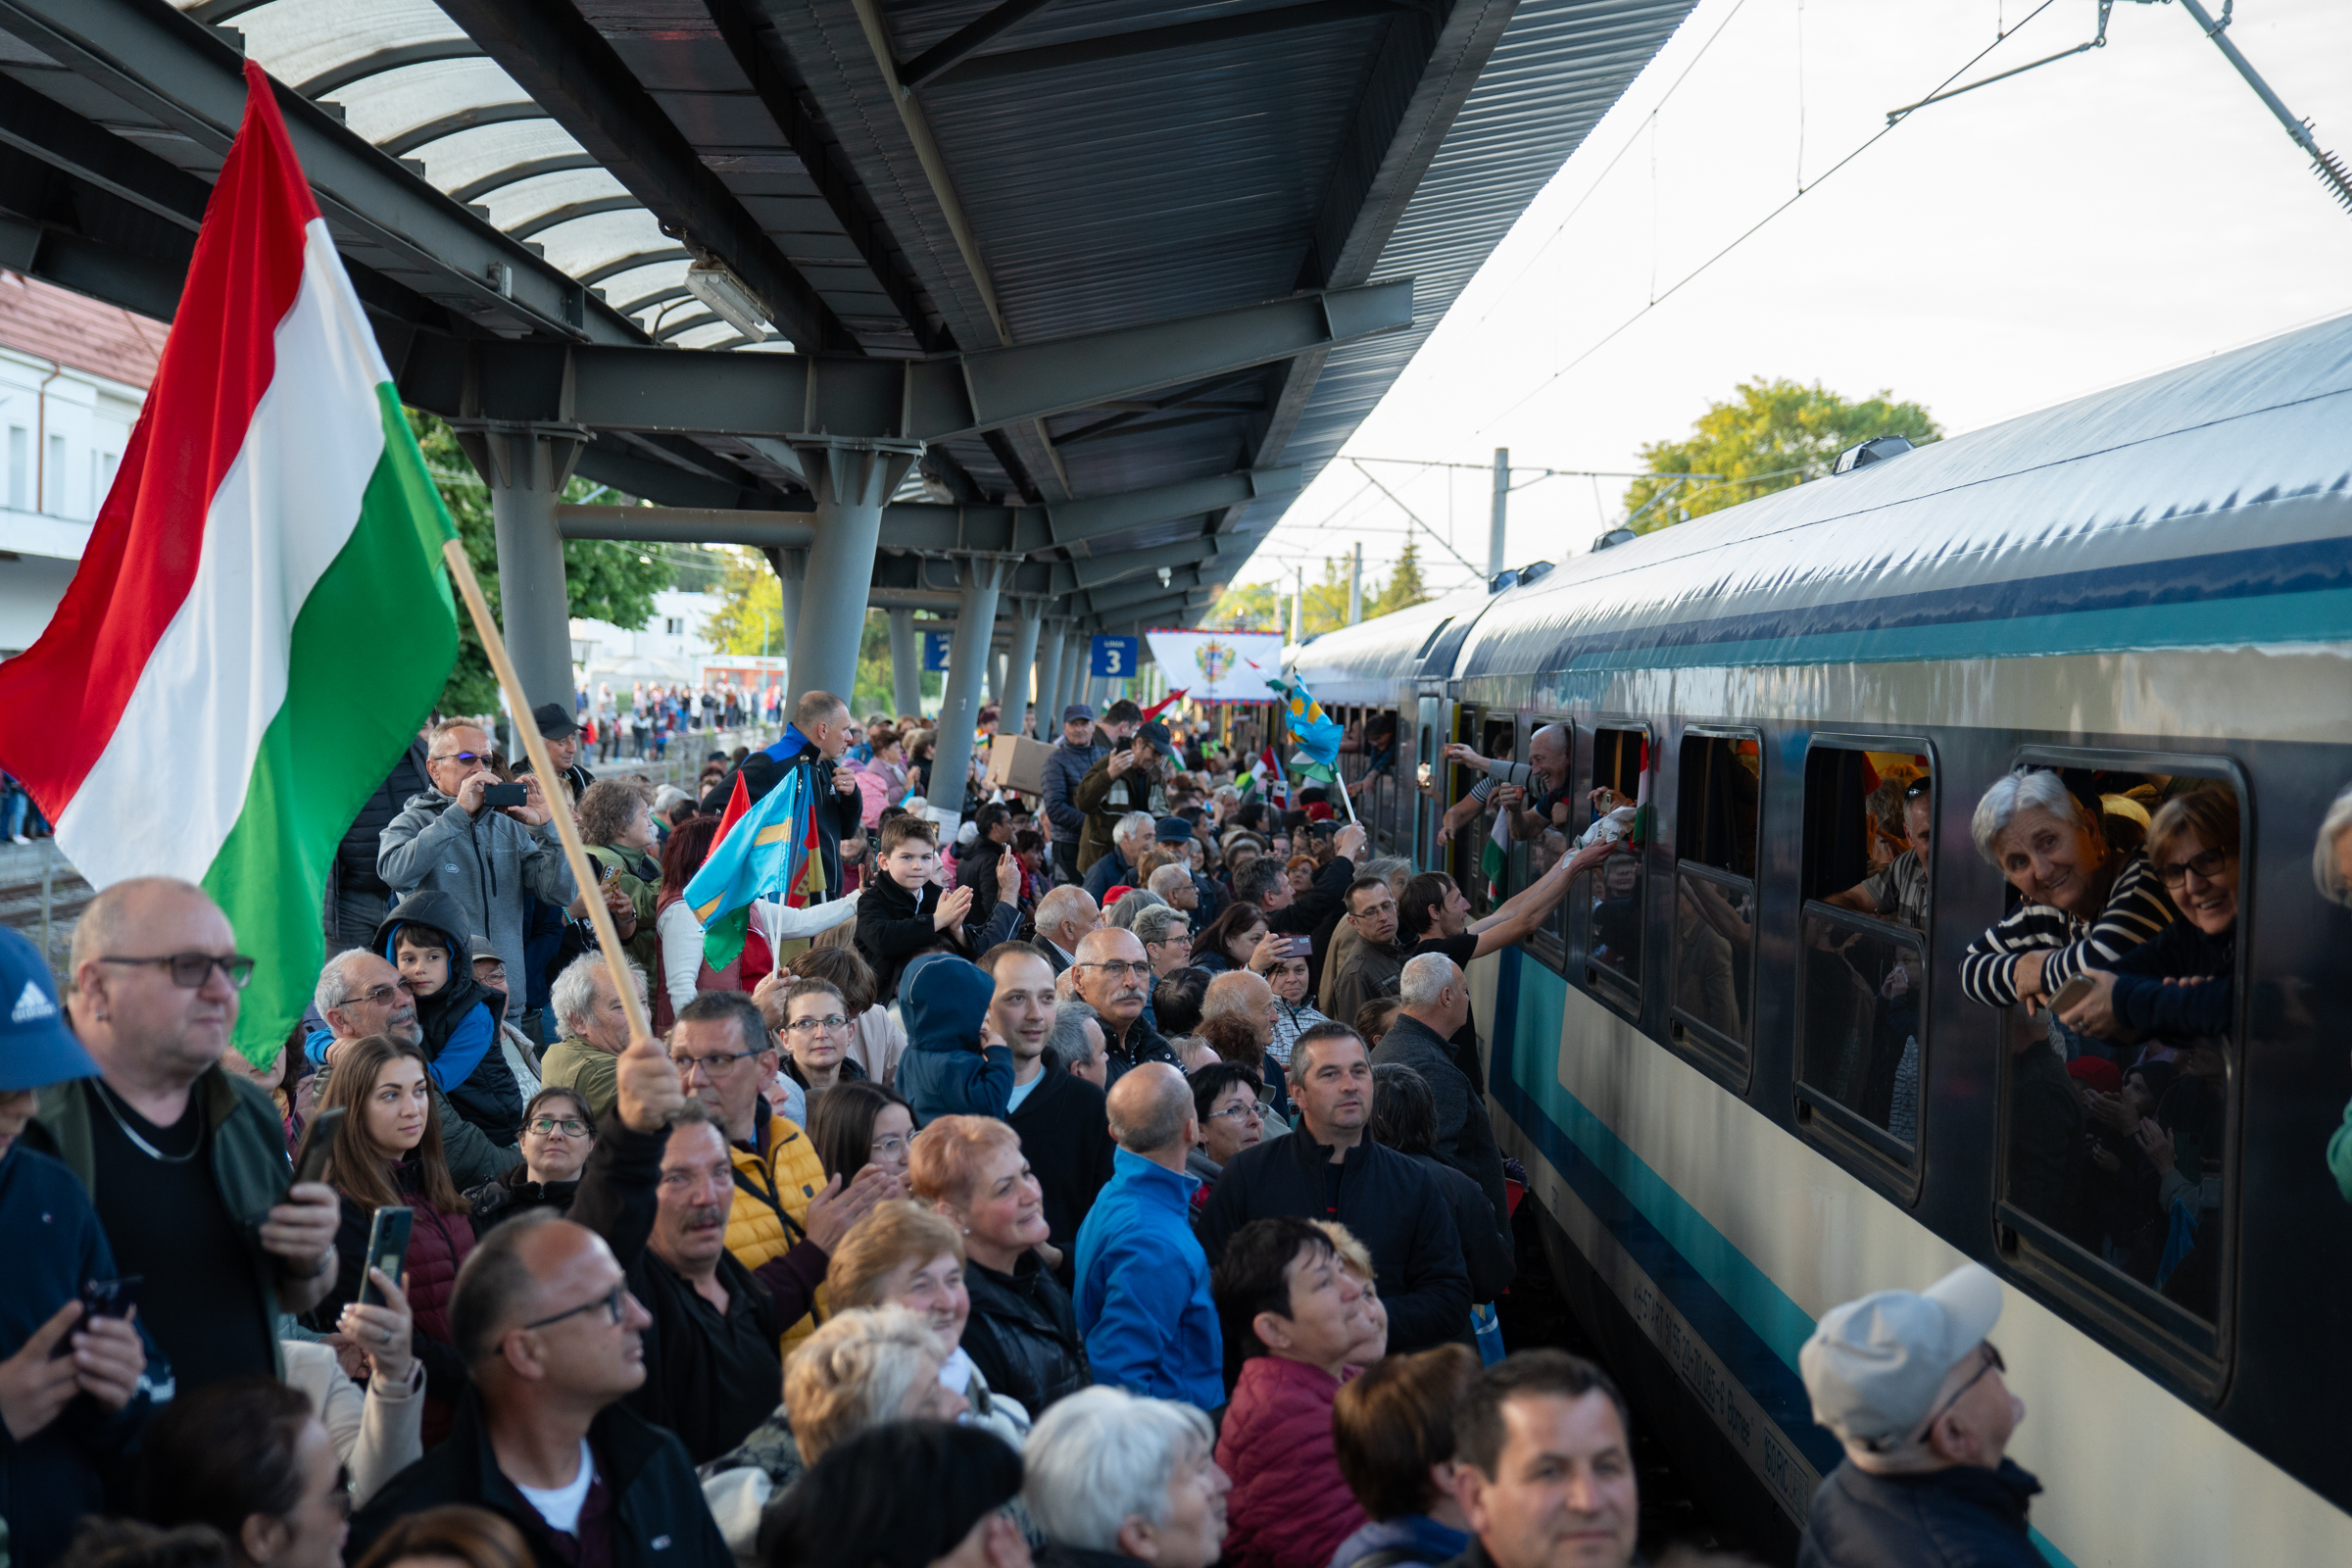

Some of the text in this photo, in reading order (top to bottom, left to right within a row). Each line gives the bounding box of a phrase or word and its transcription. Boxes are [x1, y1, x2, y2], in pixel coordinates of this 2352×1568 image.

[938, 643, 951, 667] 2
[1103, 639, 1125, 648] LINIA
[1105, 650, 1121, 674] 3
[1673, 1322, 1682, 1360] 55
[1682, 1335, 1702, 1388] 20-70
[1727, 1388, 1750, 1448] Bpmee
[1764, 1435, 1789, 1494] 160 RIC
